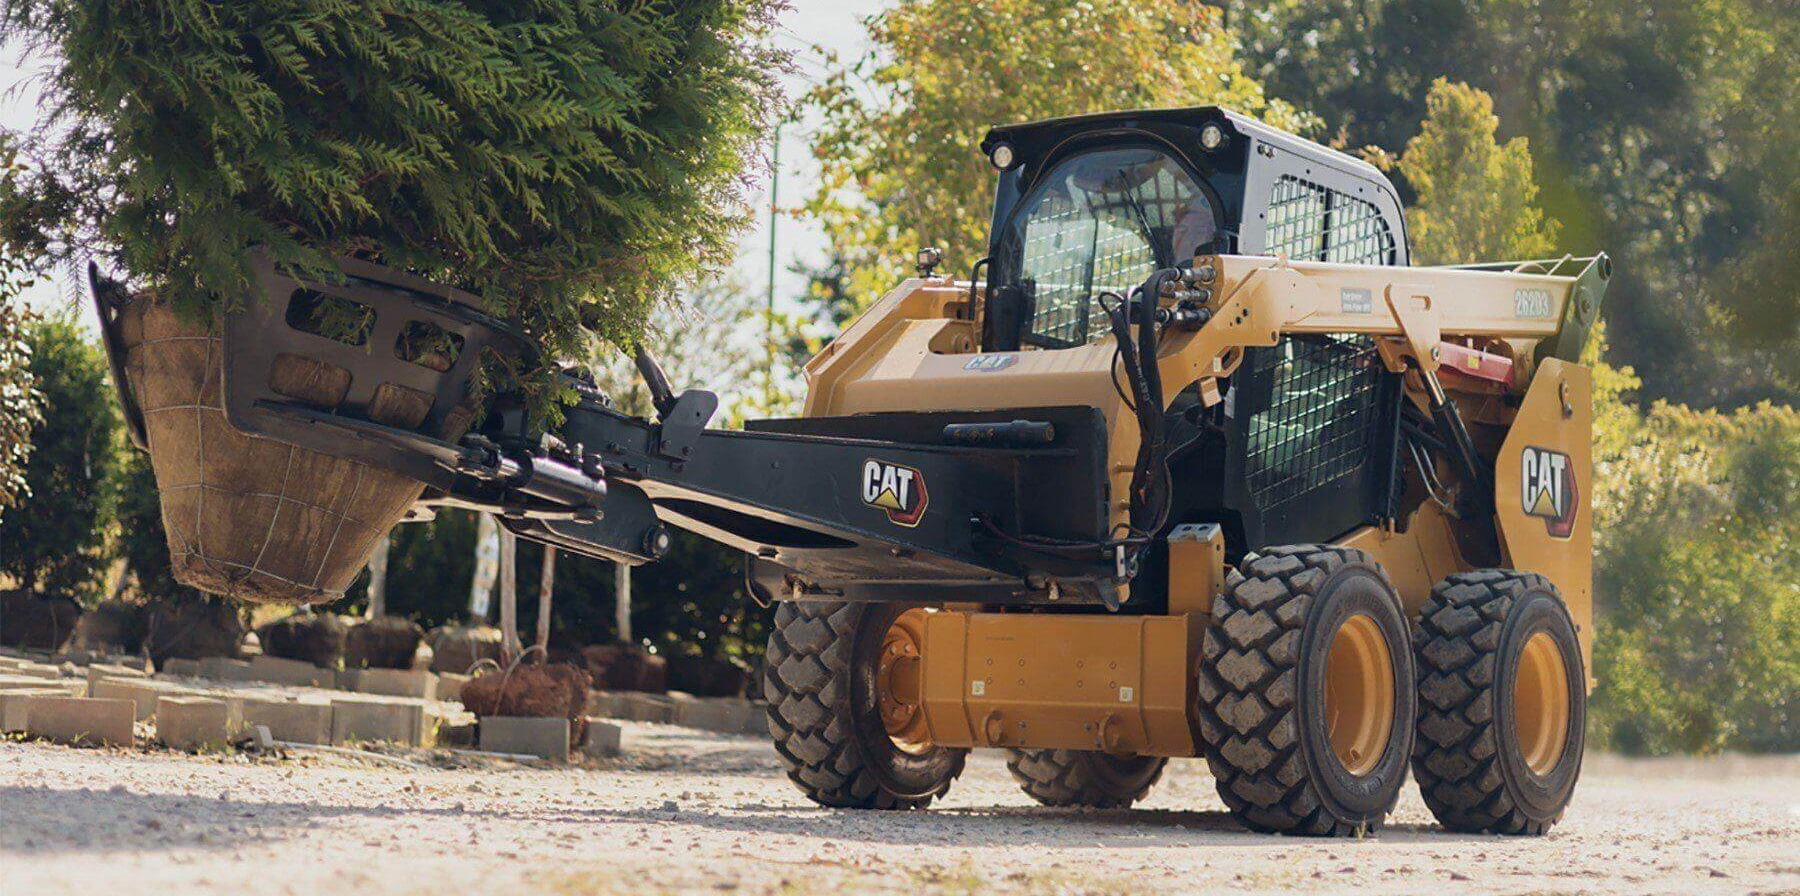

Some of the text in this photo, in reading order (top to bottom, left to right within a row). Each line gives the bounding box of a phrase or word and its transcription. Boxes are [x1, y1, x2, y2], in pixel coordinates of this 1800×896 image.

[963, 354, 1012, 370] CAT
[863, 460, 914, 510] CAT
[1522, 448, 1566, 517] CAT
